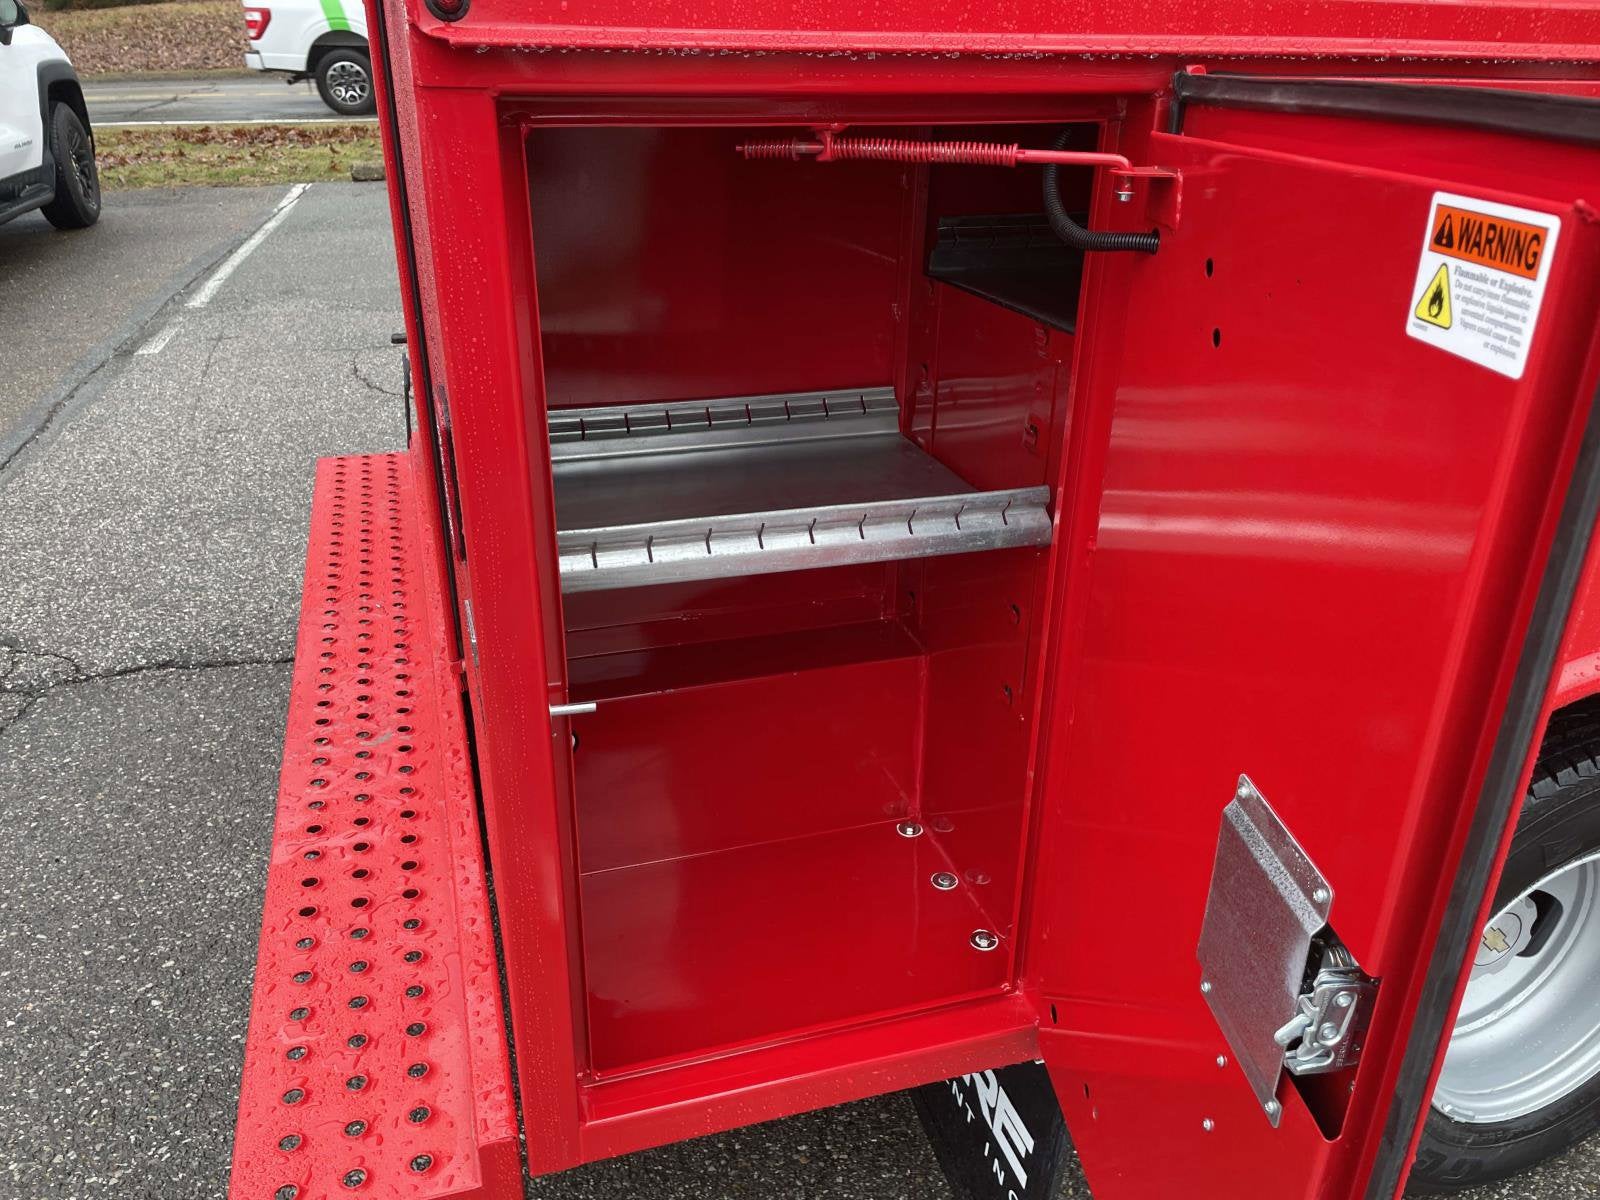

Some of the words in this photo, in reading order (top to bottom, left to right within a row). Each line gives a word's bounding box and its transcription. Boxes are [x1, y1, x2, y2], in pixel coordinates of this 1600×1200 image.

[1458, 217, 1540, 270] WARNING
[1454, 265, 1489, 285] Flammable
[1499, 278, 1533, 298] Explosive.
